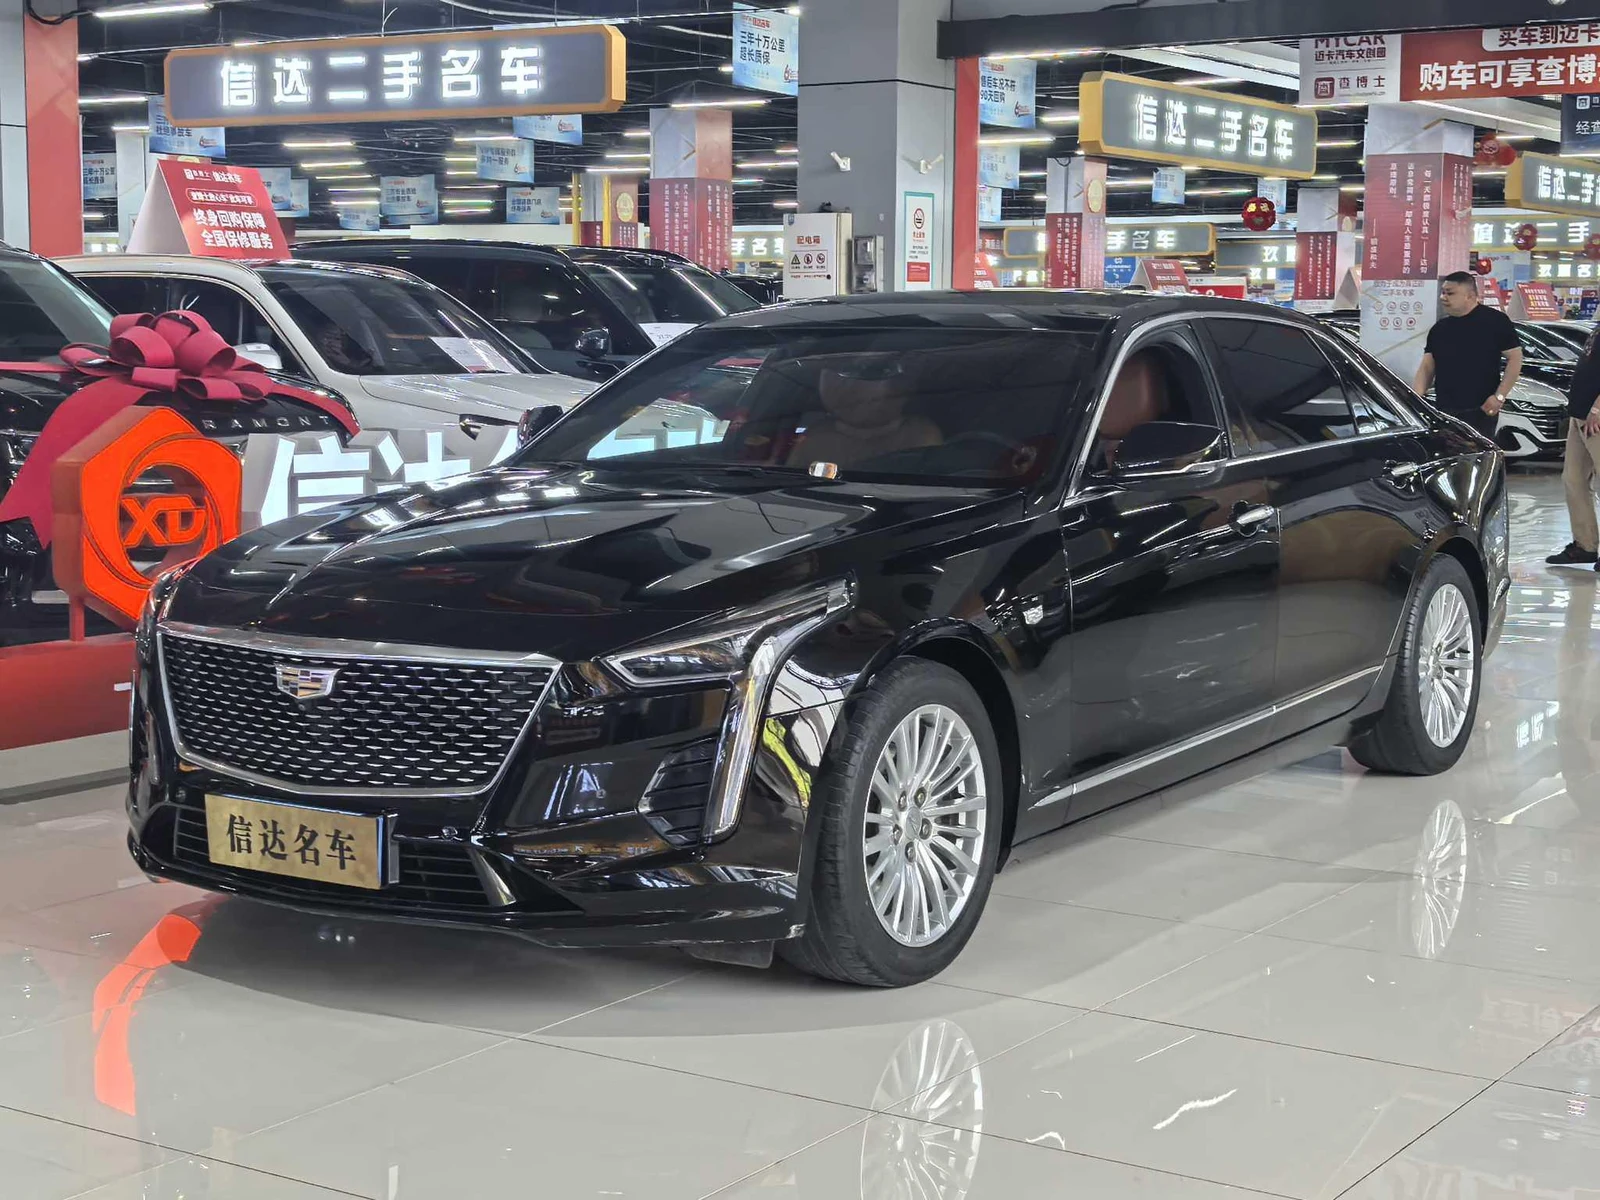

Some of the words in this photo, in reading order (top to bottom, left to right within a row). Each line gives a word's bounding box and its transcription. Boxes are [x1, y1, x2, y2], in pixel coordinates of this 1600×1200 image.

[740, 31, 785, 53] 三年十万公里
[1315, 35, 1386, 49] MYCAR
[1315, 47, 1386, 62] 迈卡汽车文创园
[220, 46, 543, 108] 信达二手名车
[1339, 75, 1386, 90] 查博士
[1419, 53, 1600, 92] 购车可享查博
[1134, 92, 1296, 162] 信达二手名车
[193, 208, 267, 230] 终身回购保障
[201, 228, 274, 250] 全国保修服务
[797, 235, 821, 245] 配电箱
[1106, 229, 1176, 251] 手名车
[1538, 263, 1600, 278] 玖名
[120, 496, 207, 547] XD
[226, 813, 357, 870] 信达名车
